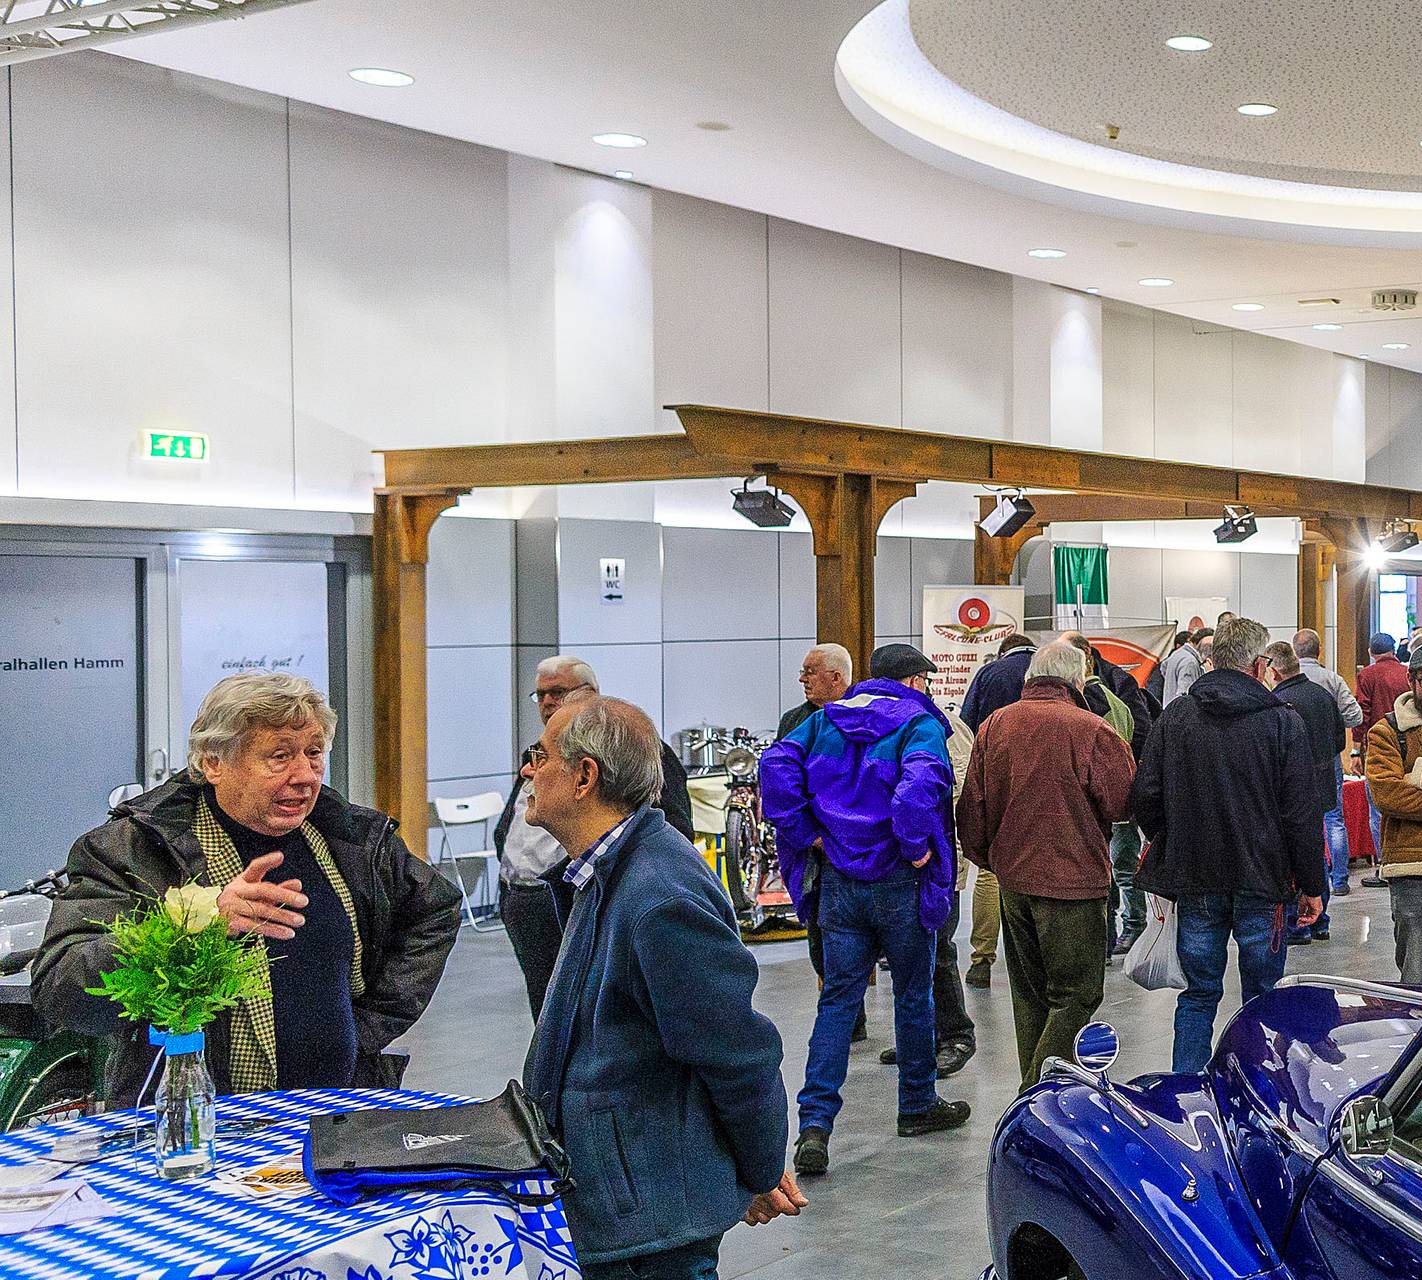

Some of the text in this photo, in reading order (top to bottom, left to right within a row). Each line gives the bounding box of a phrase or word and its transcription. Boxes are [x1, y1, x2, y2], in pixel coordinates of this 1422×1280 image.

[606, 580, 620, 589] WC
[932, 654, 978, 662] MOTO GUZZI
[74, 658, 124, 669] Hamm
[938, 665, 971, 675] nzylinder
